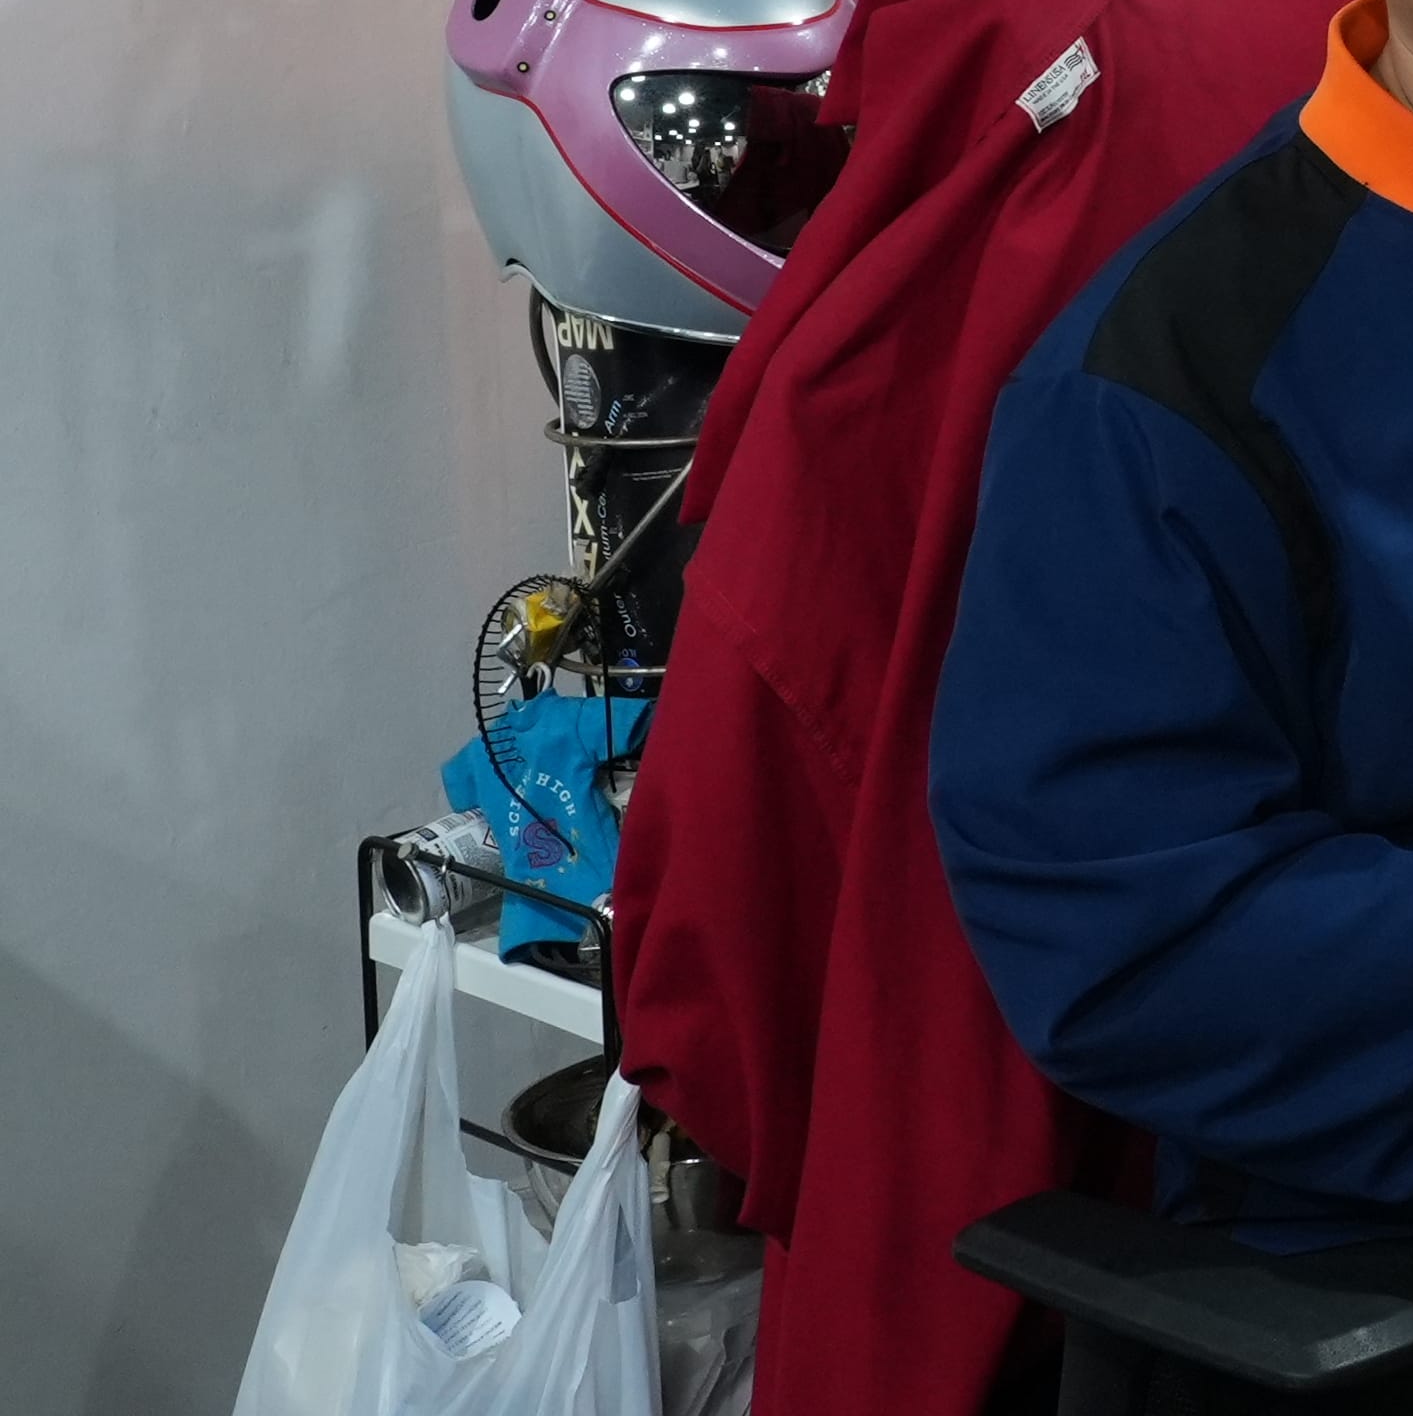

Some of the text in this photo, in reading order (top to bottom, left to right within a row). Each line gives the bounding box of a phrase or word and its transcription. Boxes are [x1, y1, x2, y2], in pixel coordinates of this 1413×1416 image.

[605, 399, 622, 435] Arm
[614, 592, 638, 638] Outer
[536, 772, 576, 817] HIGH
